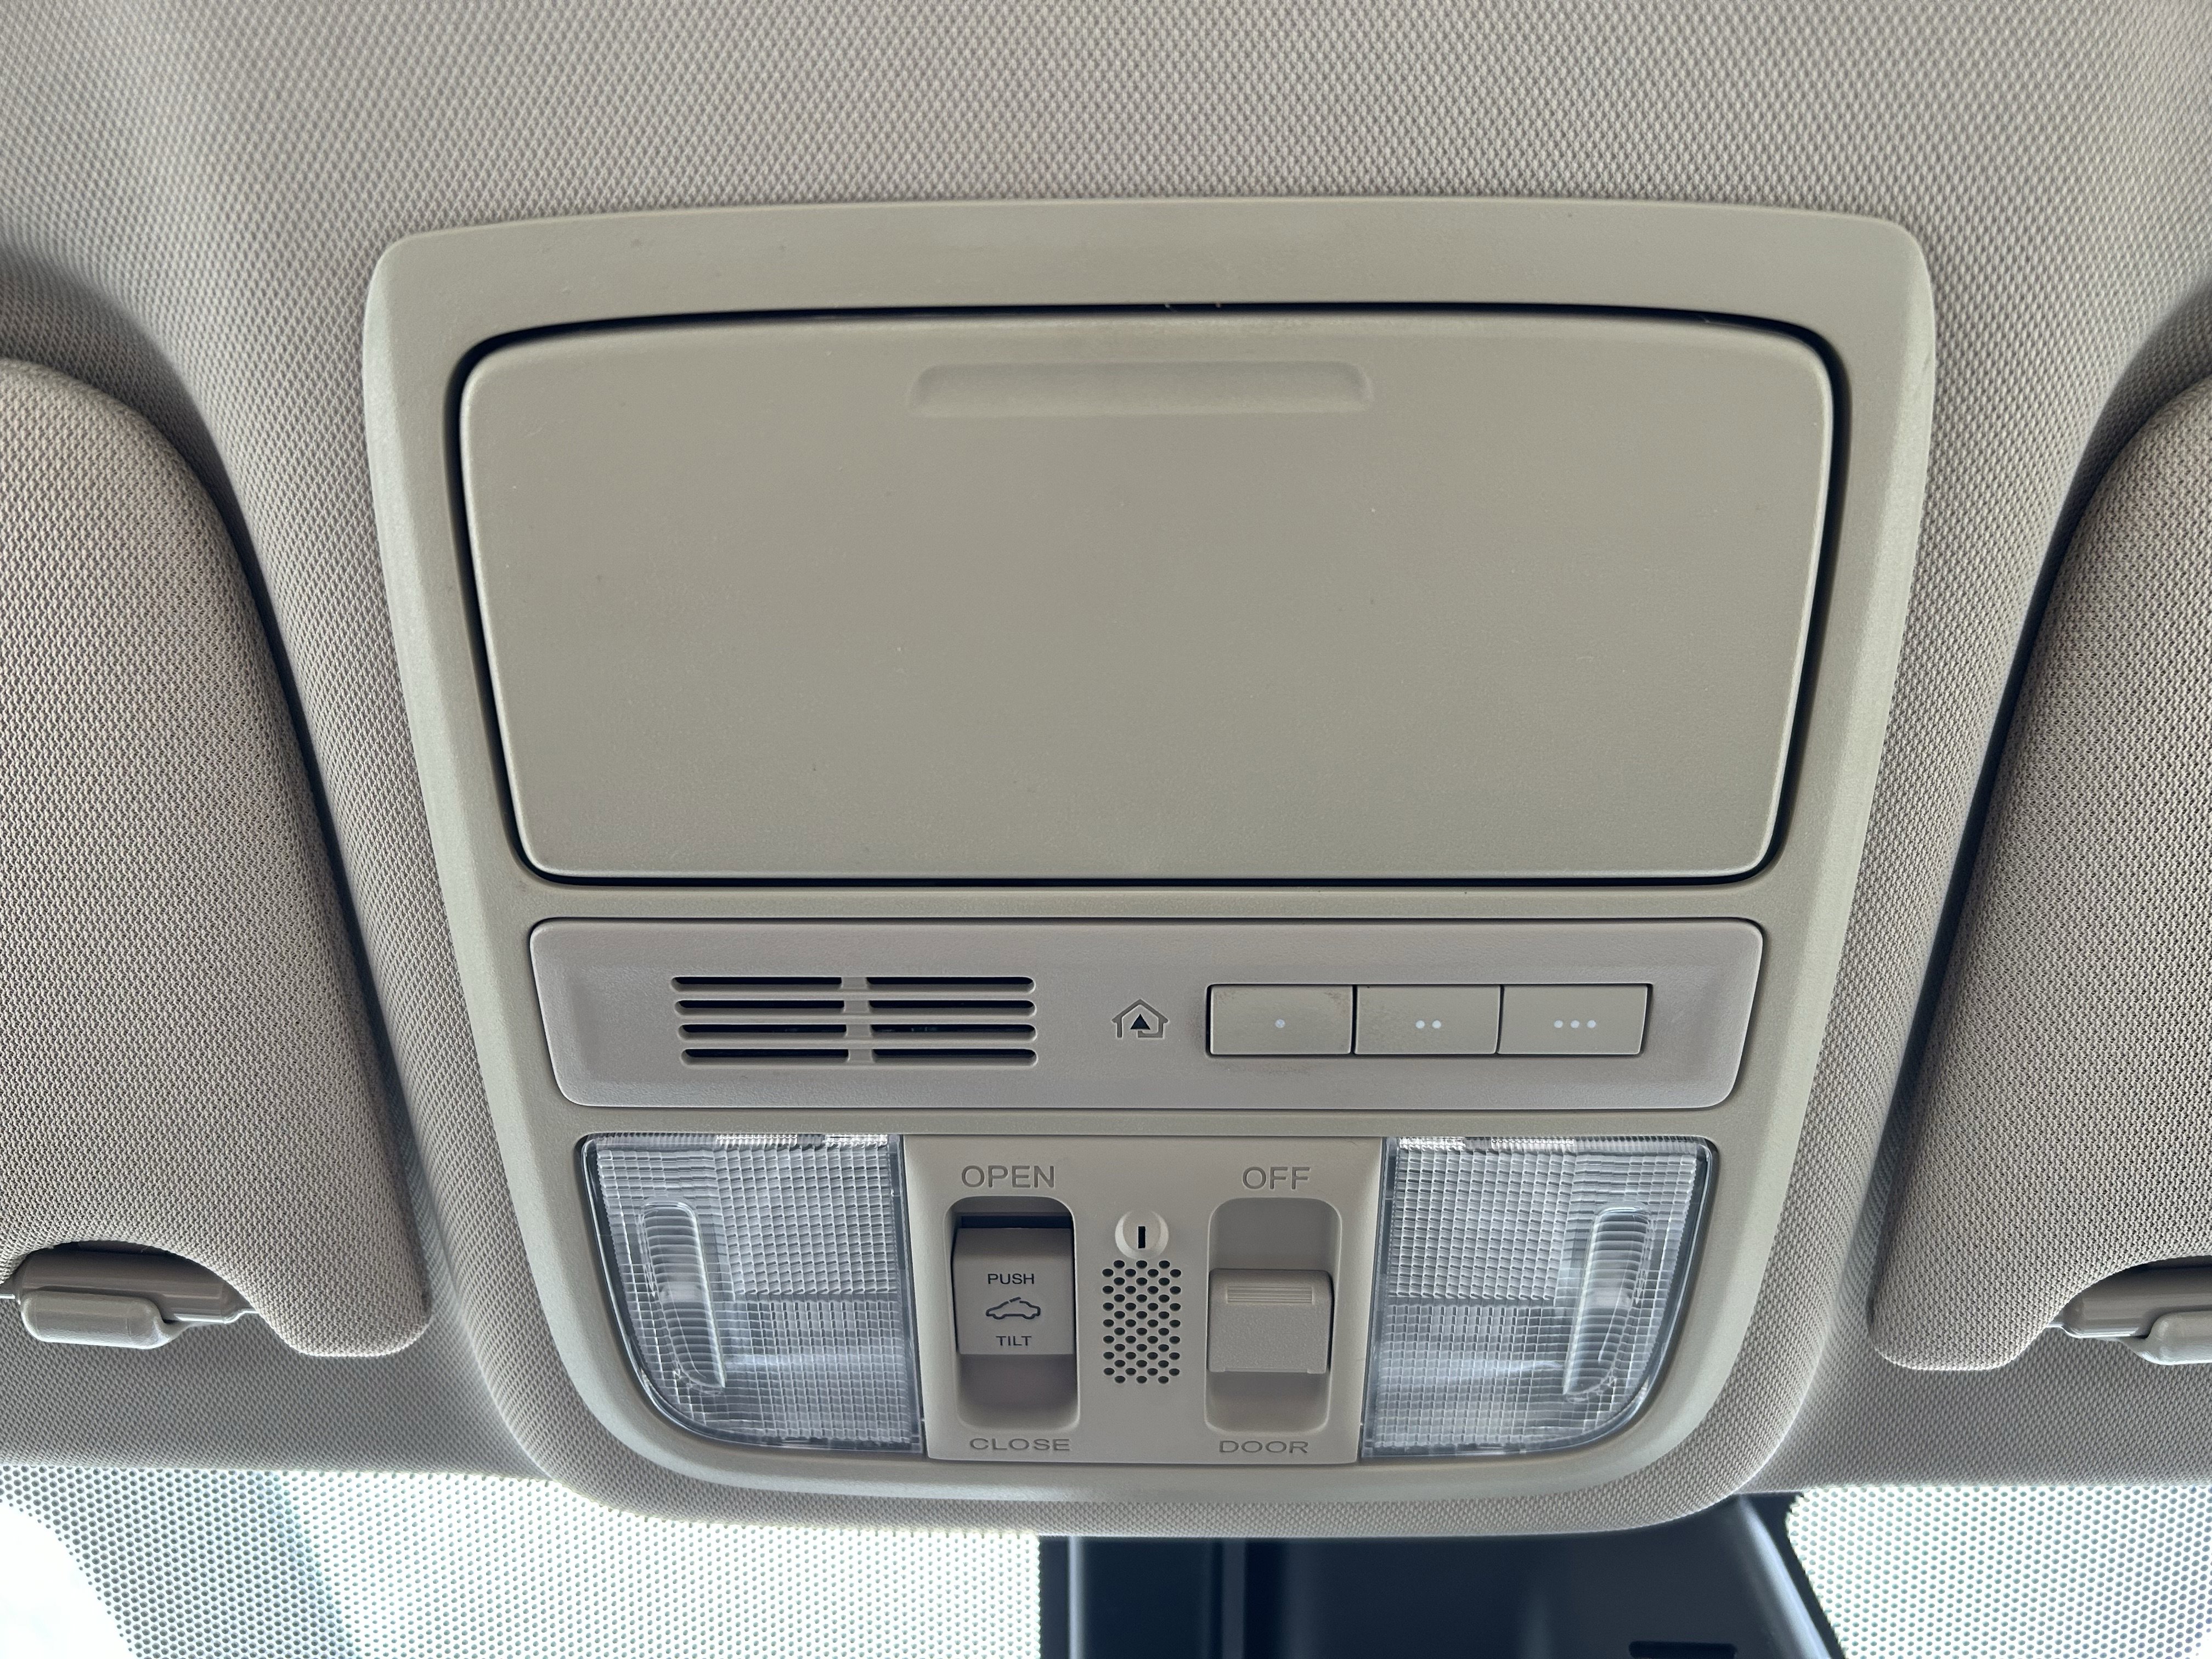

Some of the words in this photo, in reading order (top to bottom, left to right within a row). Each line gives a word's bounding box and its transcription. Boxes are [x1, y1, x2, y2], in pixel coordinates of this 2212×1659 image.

[961, 1165, 1054, 1188] OPEN
[1243, 1166, 1311, 1189] OFF
[988, 1273, 1035, 1284] PUSH
[996, 1335, 1031, 1346] TILT
[969, 1437, 1070, 1451] CLOSE
[1218, 1440, 1310, 1453] DOOR
